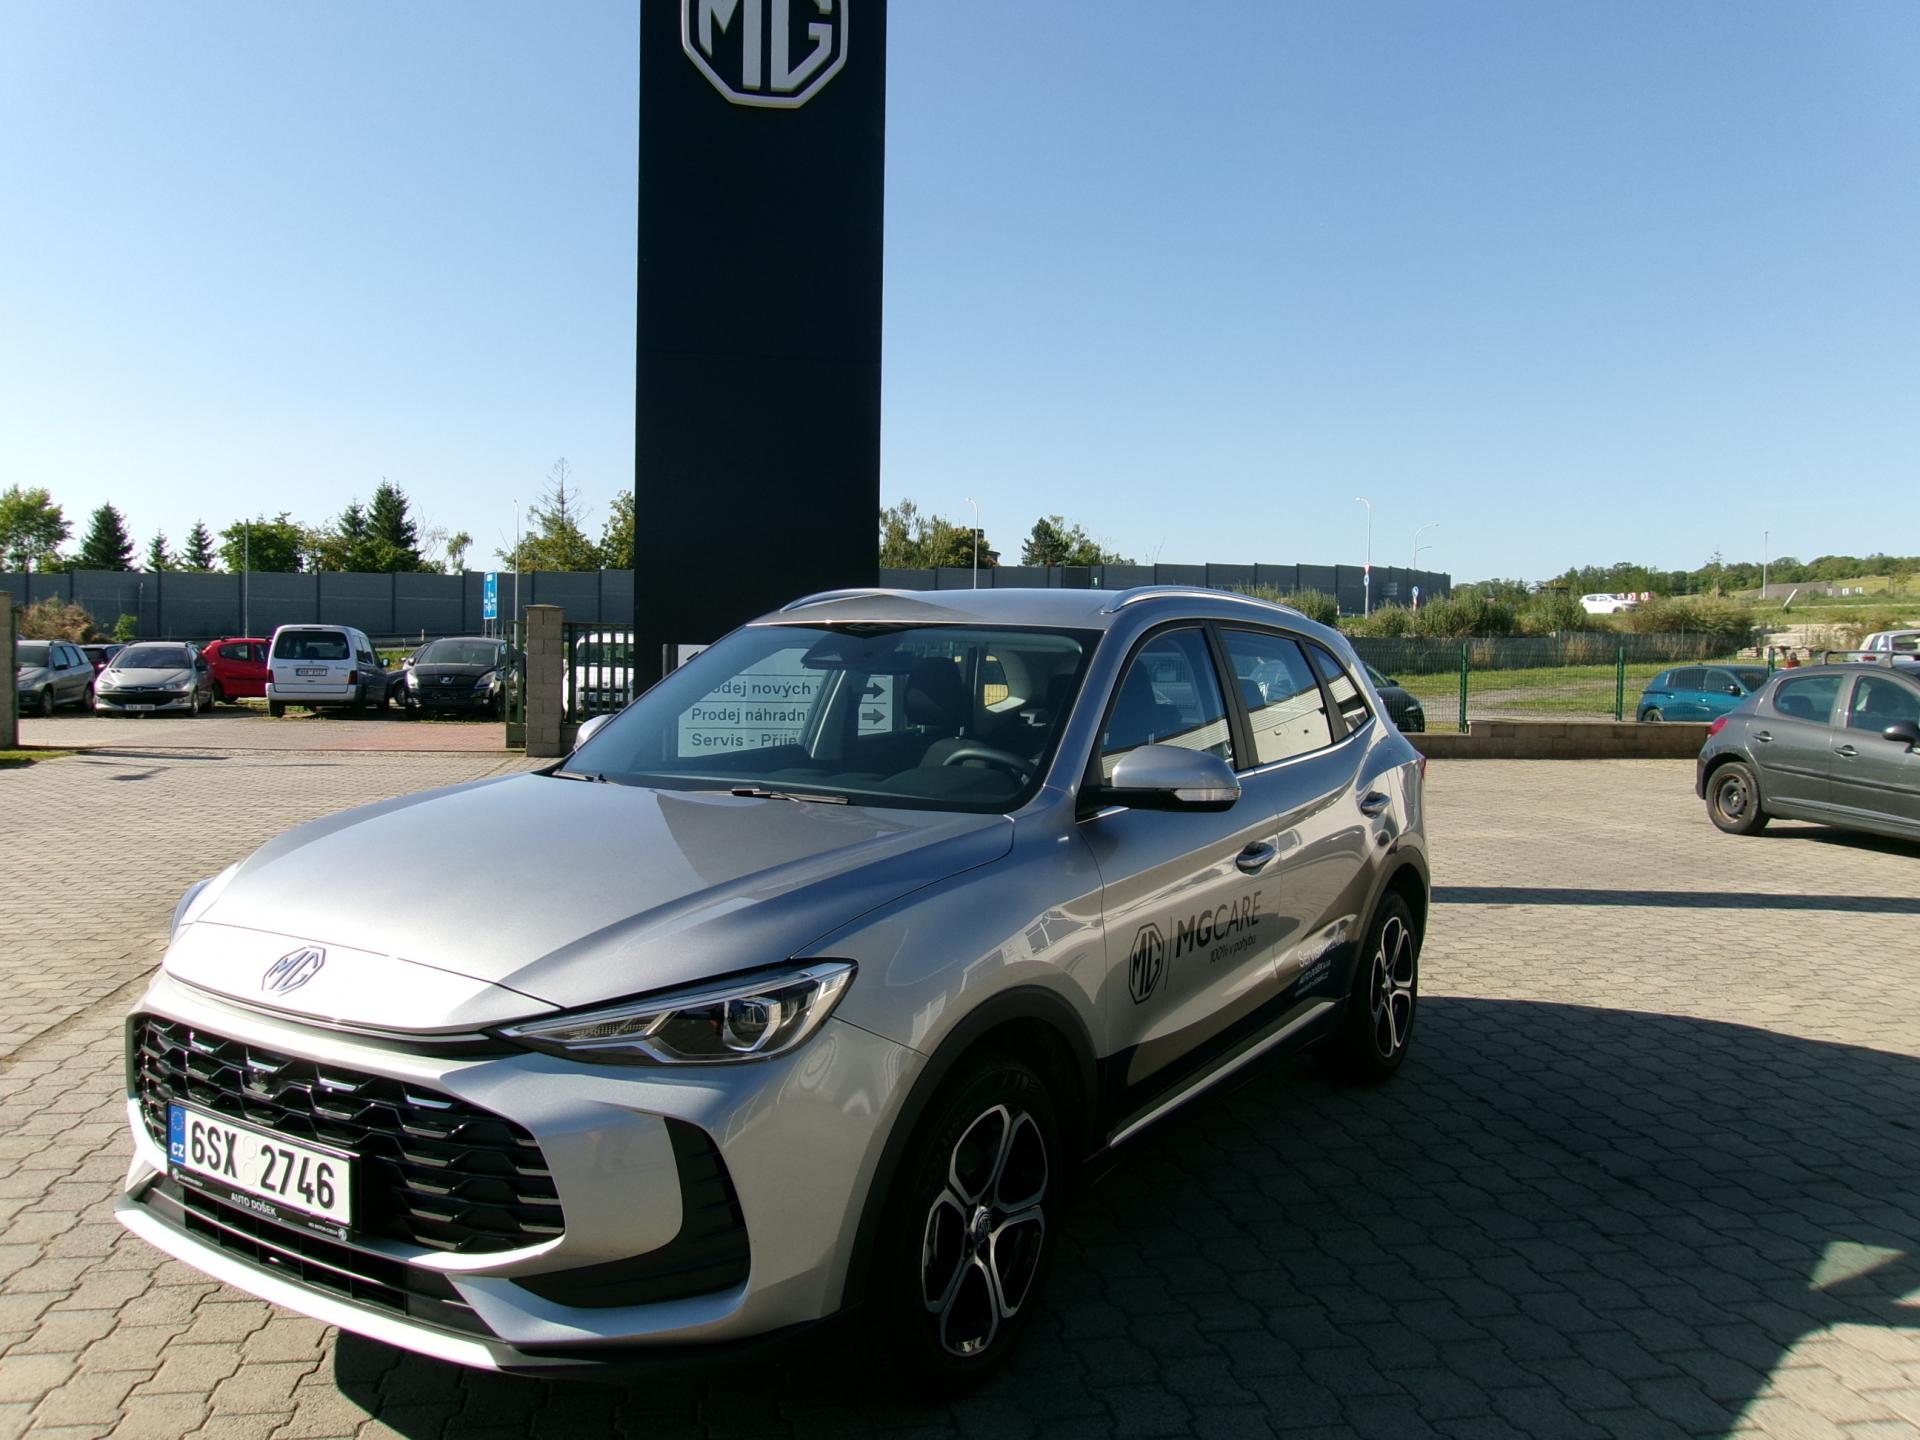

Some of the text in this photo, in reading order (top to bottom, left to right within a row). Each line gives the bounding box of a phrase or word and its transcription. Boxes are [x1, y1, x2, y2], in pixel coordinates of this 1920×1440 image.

[698, 0, 834, 93] MG
[711, 681, 747, 698] odej
[751, 681, 811, 698] nových
[691, 707, 740, 724] Prodej
[691, 733, 744, 747] Servis
[761, 733, 798, 747] Příje
[1175, 890, 1263, 959] MGCARE
[1131, 929, 1161, 998] MG
[171, 1142, 185, 1158] CZ
[191, 1120, 335, 1210] 6SX 2746
[231, 1192, 250, 1208] AUTO
